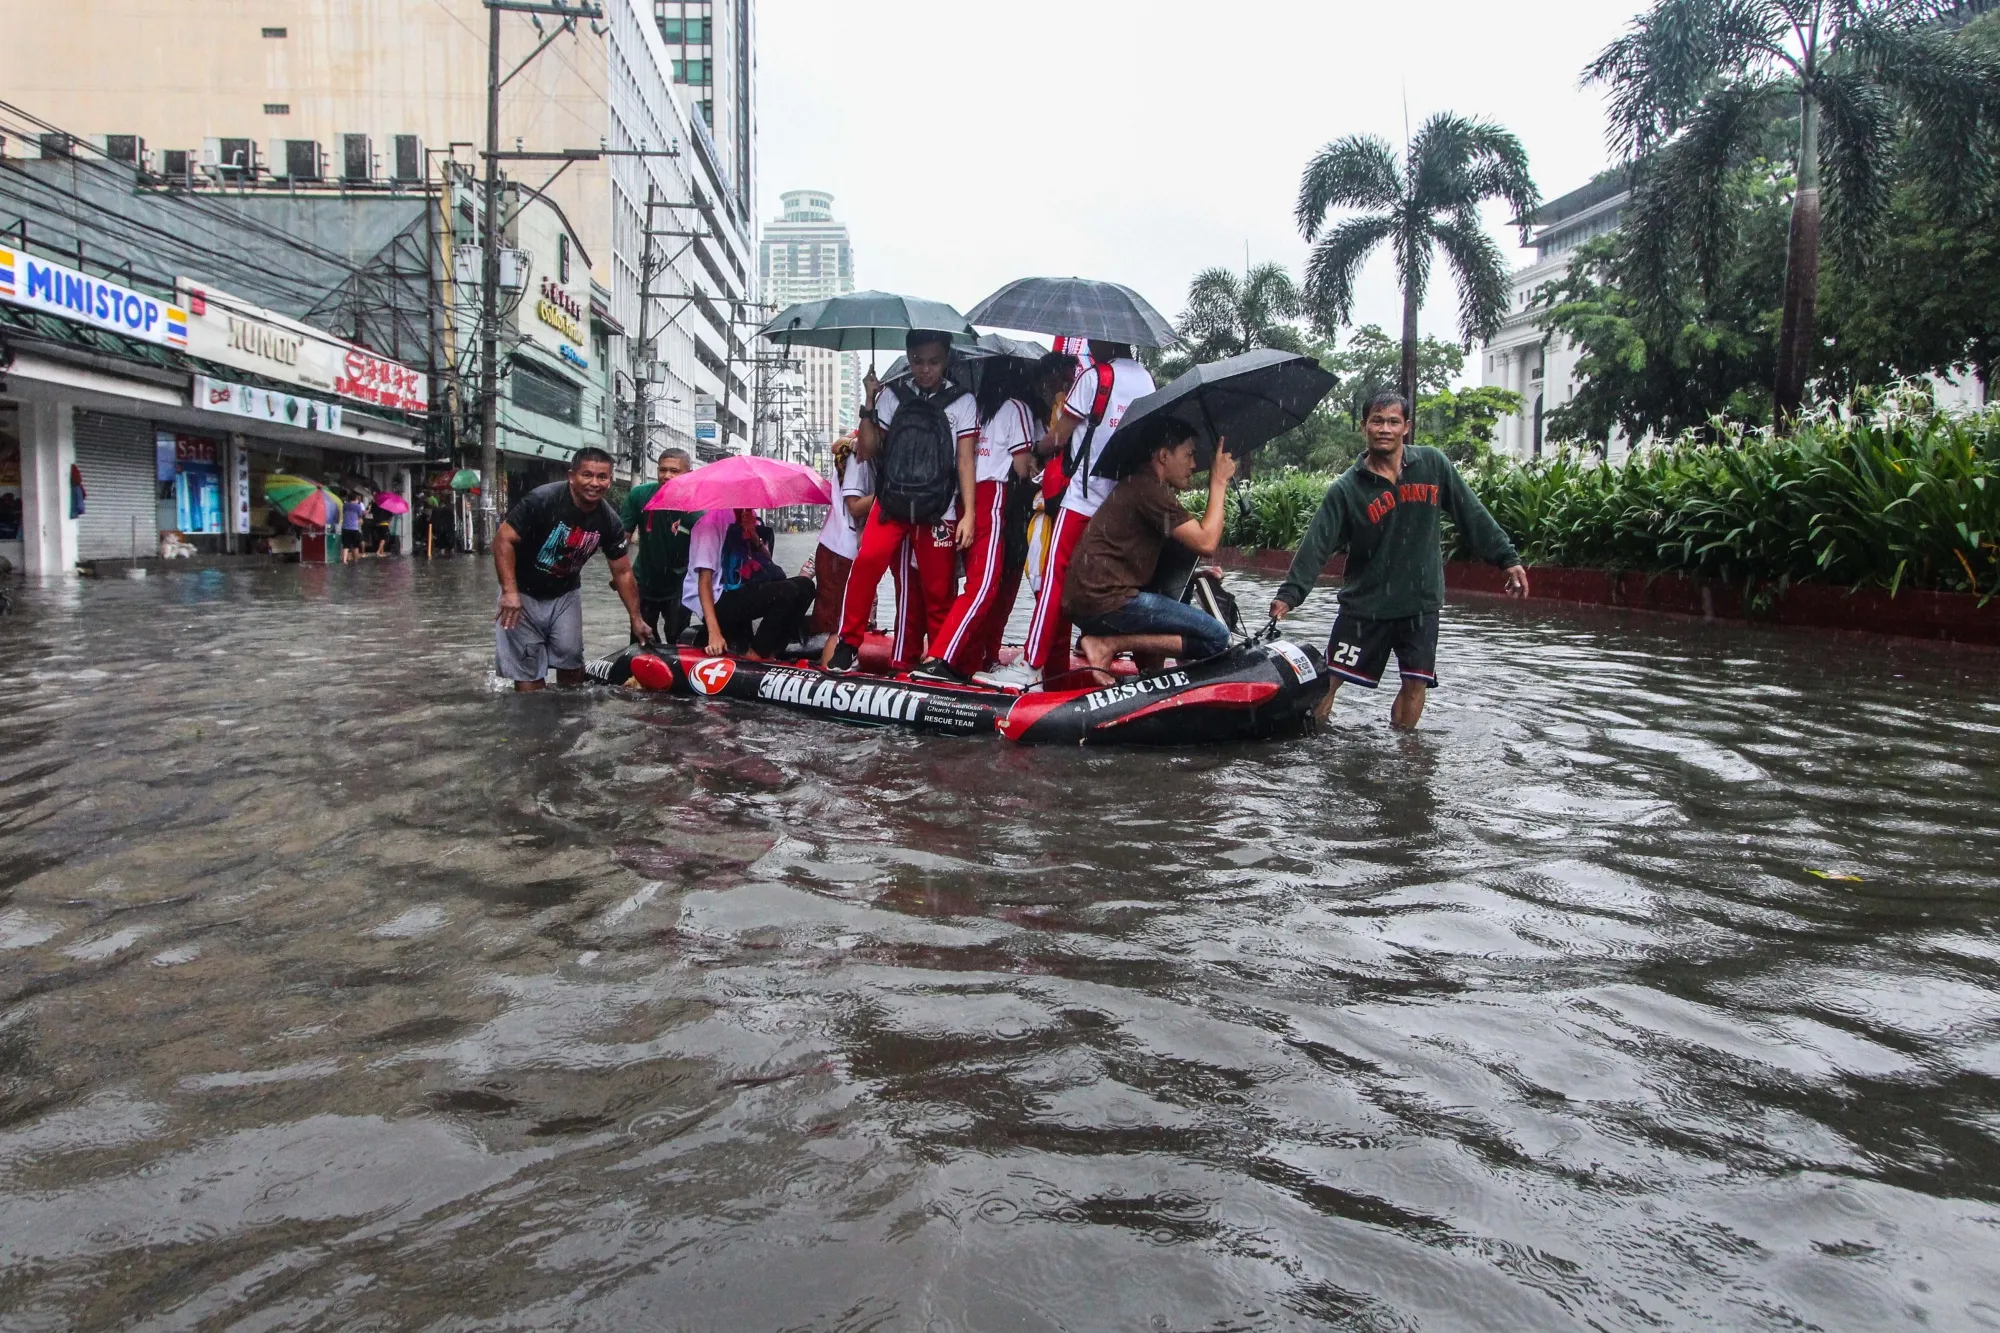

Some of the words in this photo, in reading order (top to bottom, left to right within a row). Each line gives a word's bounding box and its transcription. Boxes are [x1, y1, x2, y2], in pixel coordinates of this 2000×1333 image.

[27, 261, 159, 332] MINISTOP
[178, 440, 214, 460] Sale
[1367, 491, 1396, 524] OLD
[1399, 483, 1439, 506] NAVY
[1333, 641, 1362, 667] 25
[770, 667, 822, 679] OPERATION
[757, 671, 929, 721] MALASAKIT
[1085, 670, 1190, 711] RESCUE
[924, 715, 953, 725] RESCUE
[954, 719, 974, 728] TEAM
[927, 705, 950, 714] Church
[955, 709, 977, 718] Manila
